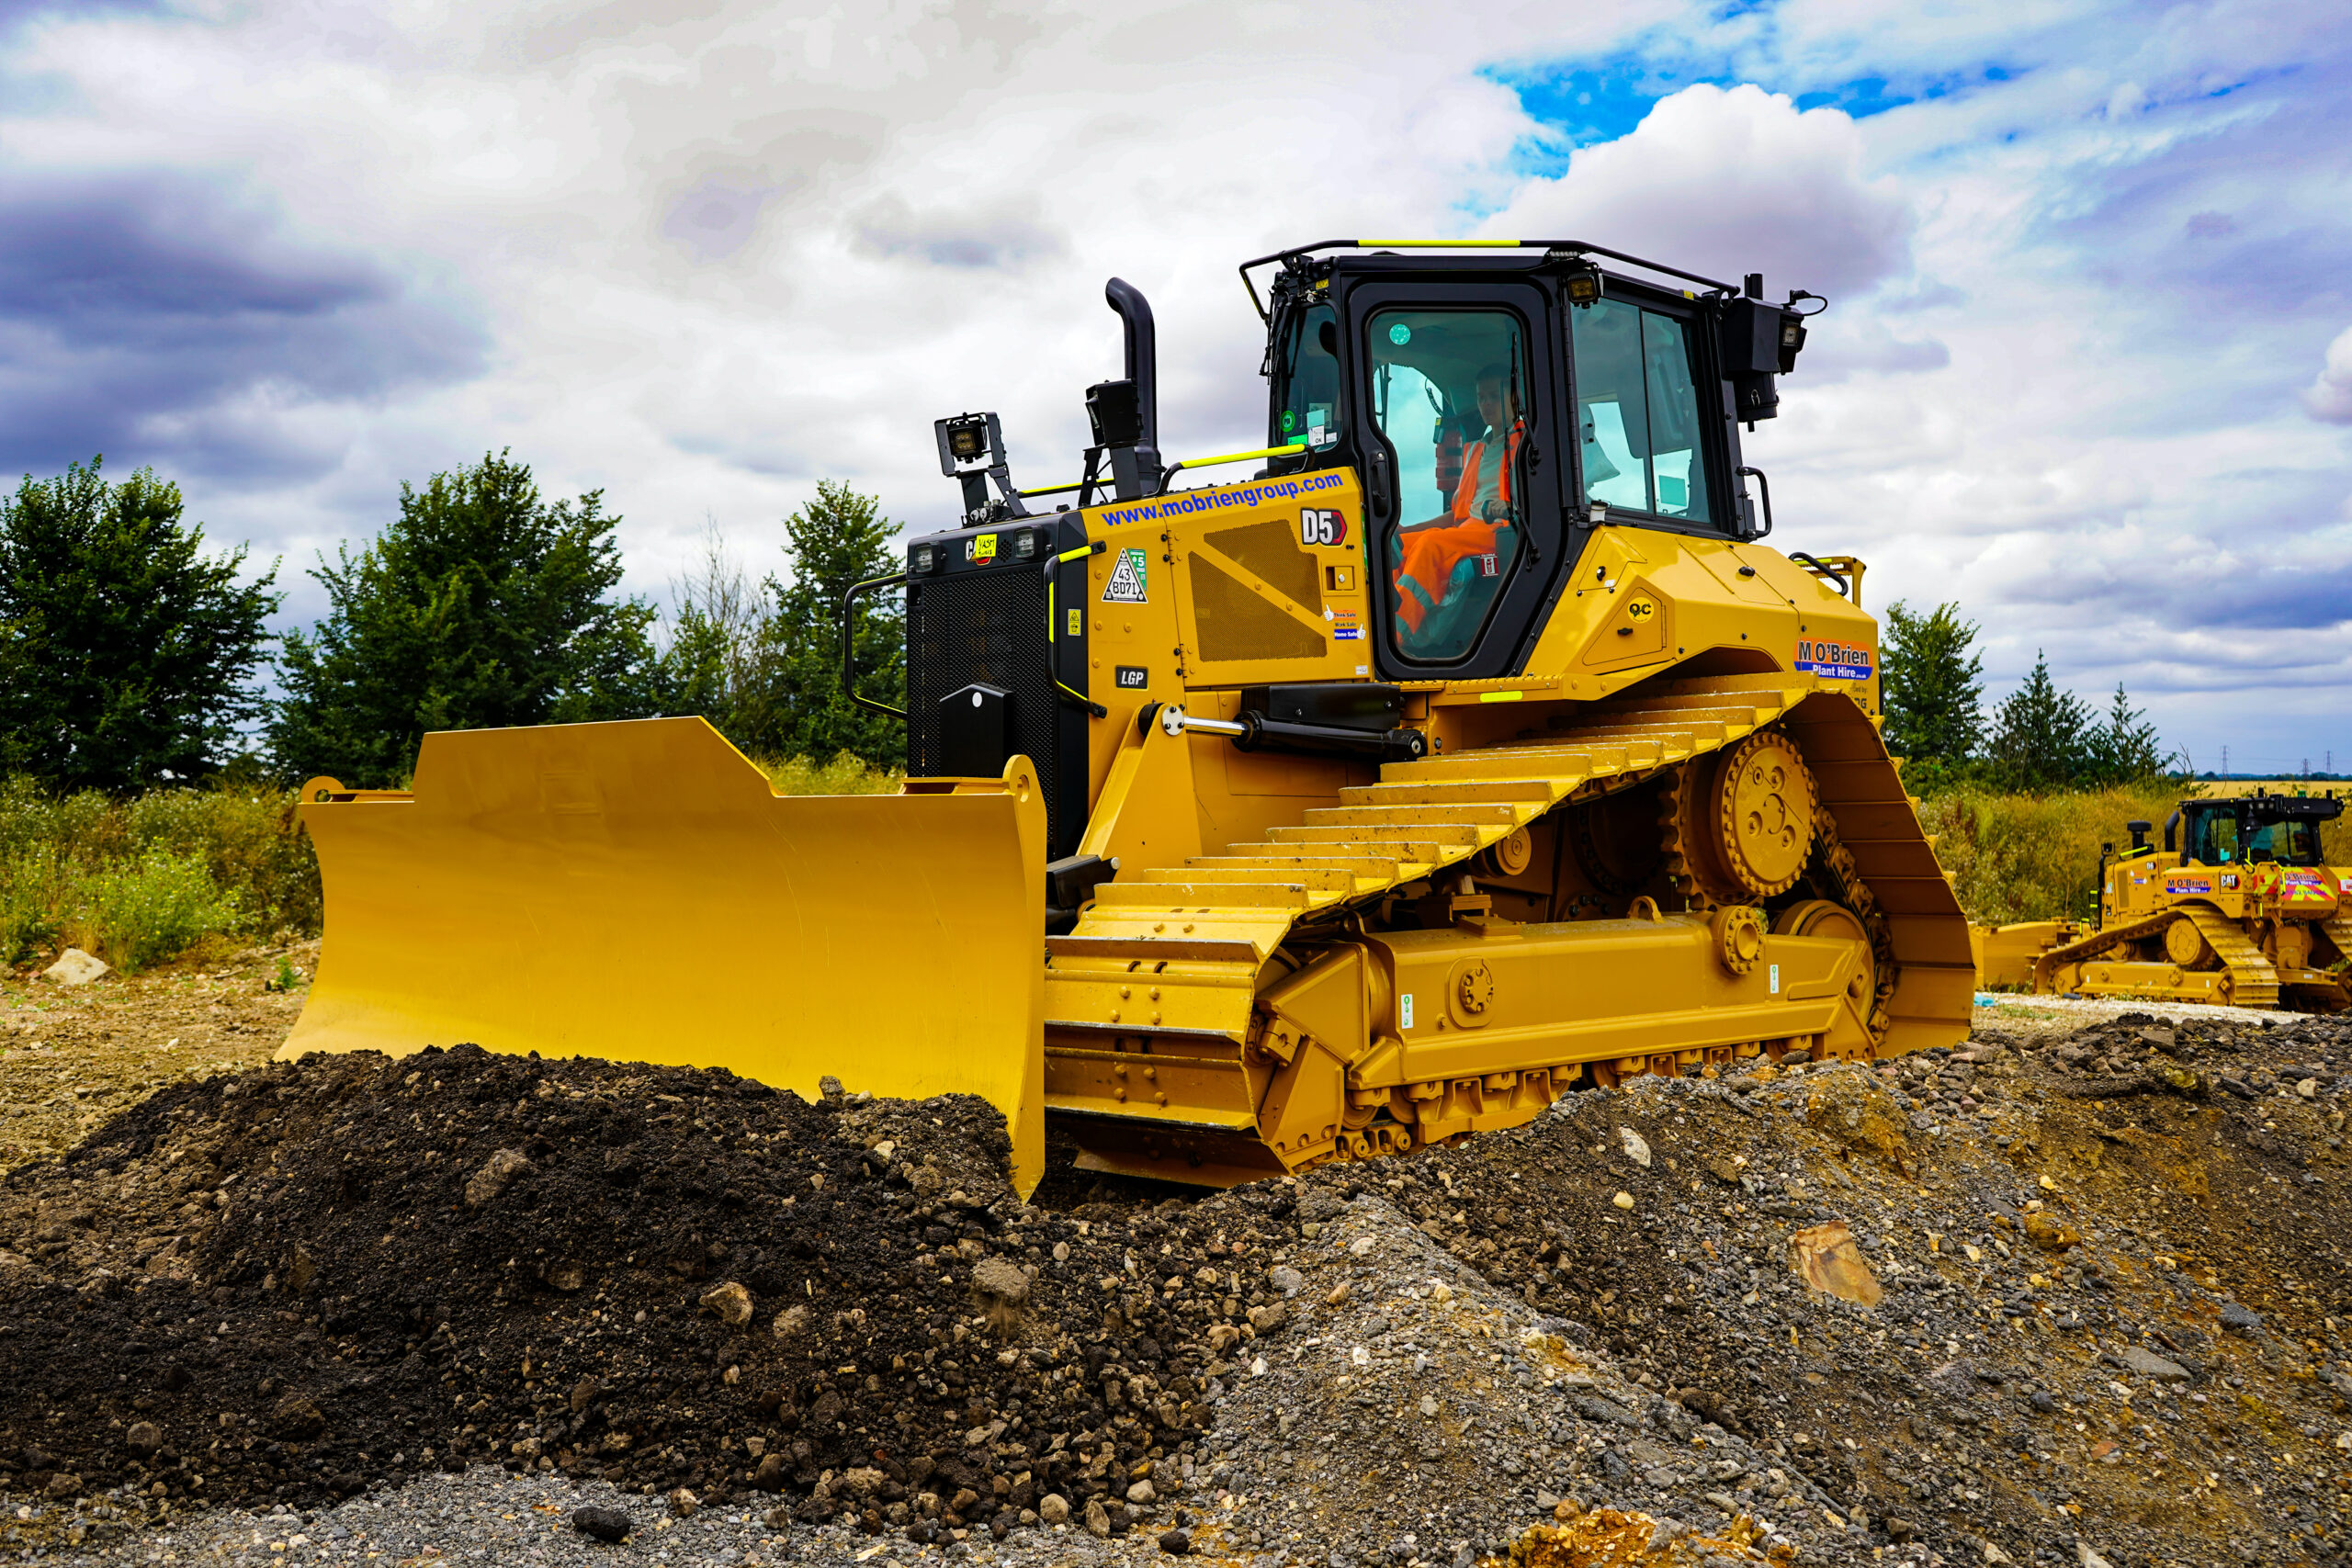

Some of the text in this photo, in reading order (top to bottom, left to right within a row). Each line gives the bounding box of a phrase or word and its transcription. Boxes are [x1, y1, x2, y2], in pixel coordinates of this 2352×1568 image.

[1102, 473, 1344, 526] www.mobriengroup.com
[1302, 510, 1333, 544] D5
[1137, 557, 1145, 567] 5
[1118, 568, 1130, 581] 43
[1798, 641, 1869, 665] M O'Brien
[1813, 664, 1836, 677] Plant
[1121, 671, 1144, 685] LGP
[2167, 878, 2209, 887] M O'Brien
[2221, 874, 2236, 887] CAT
